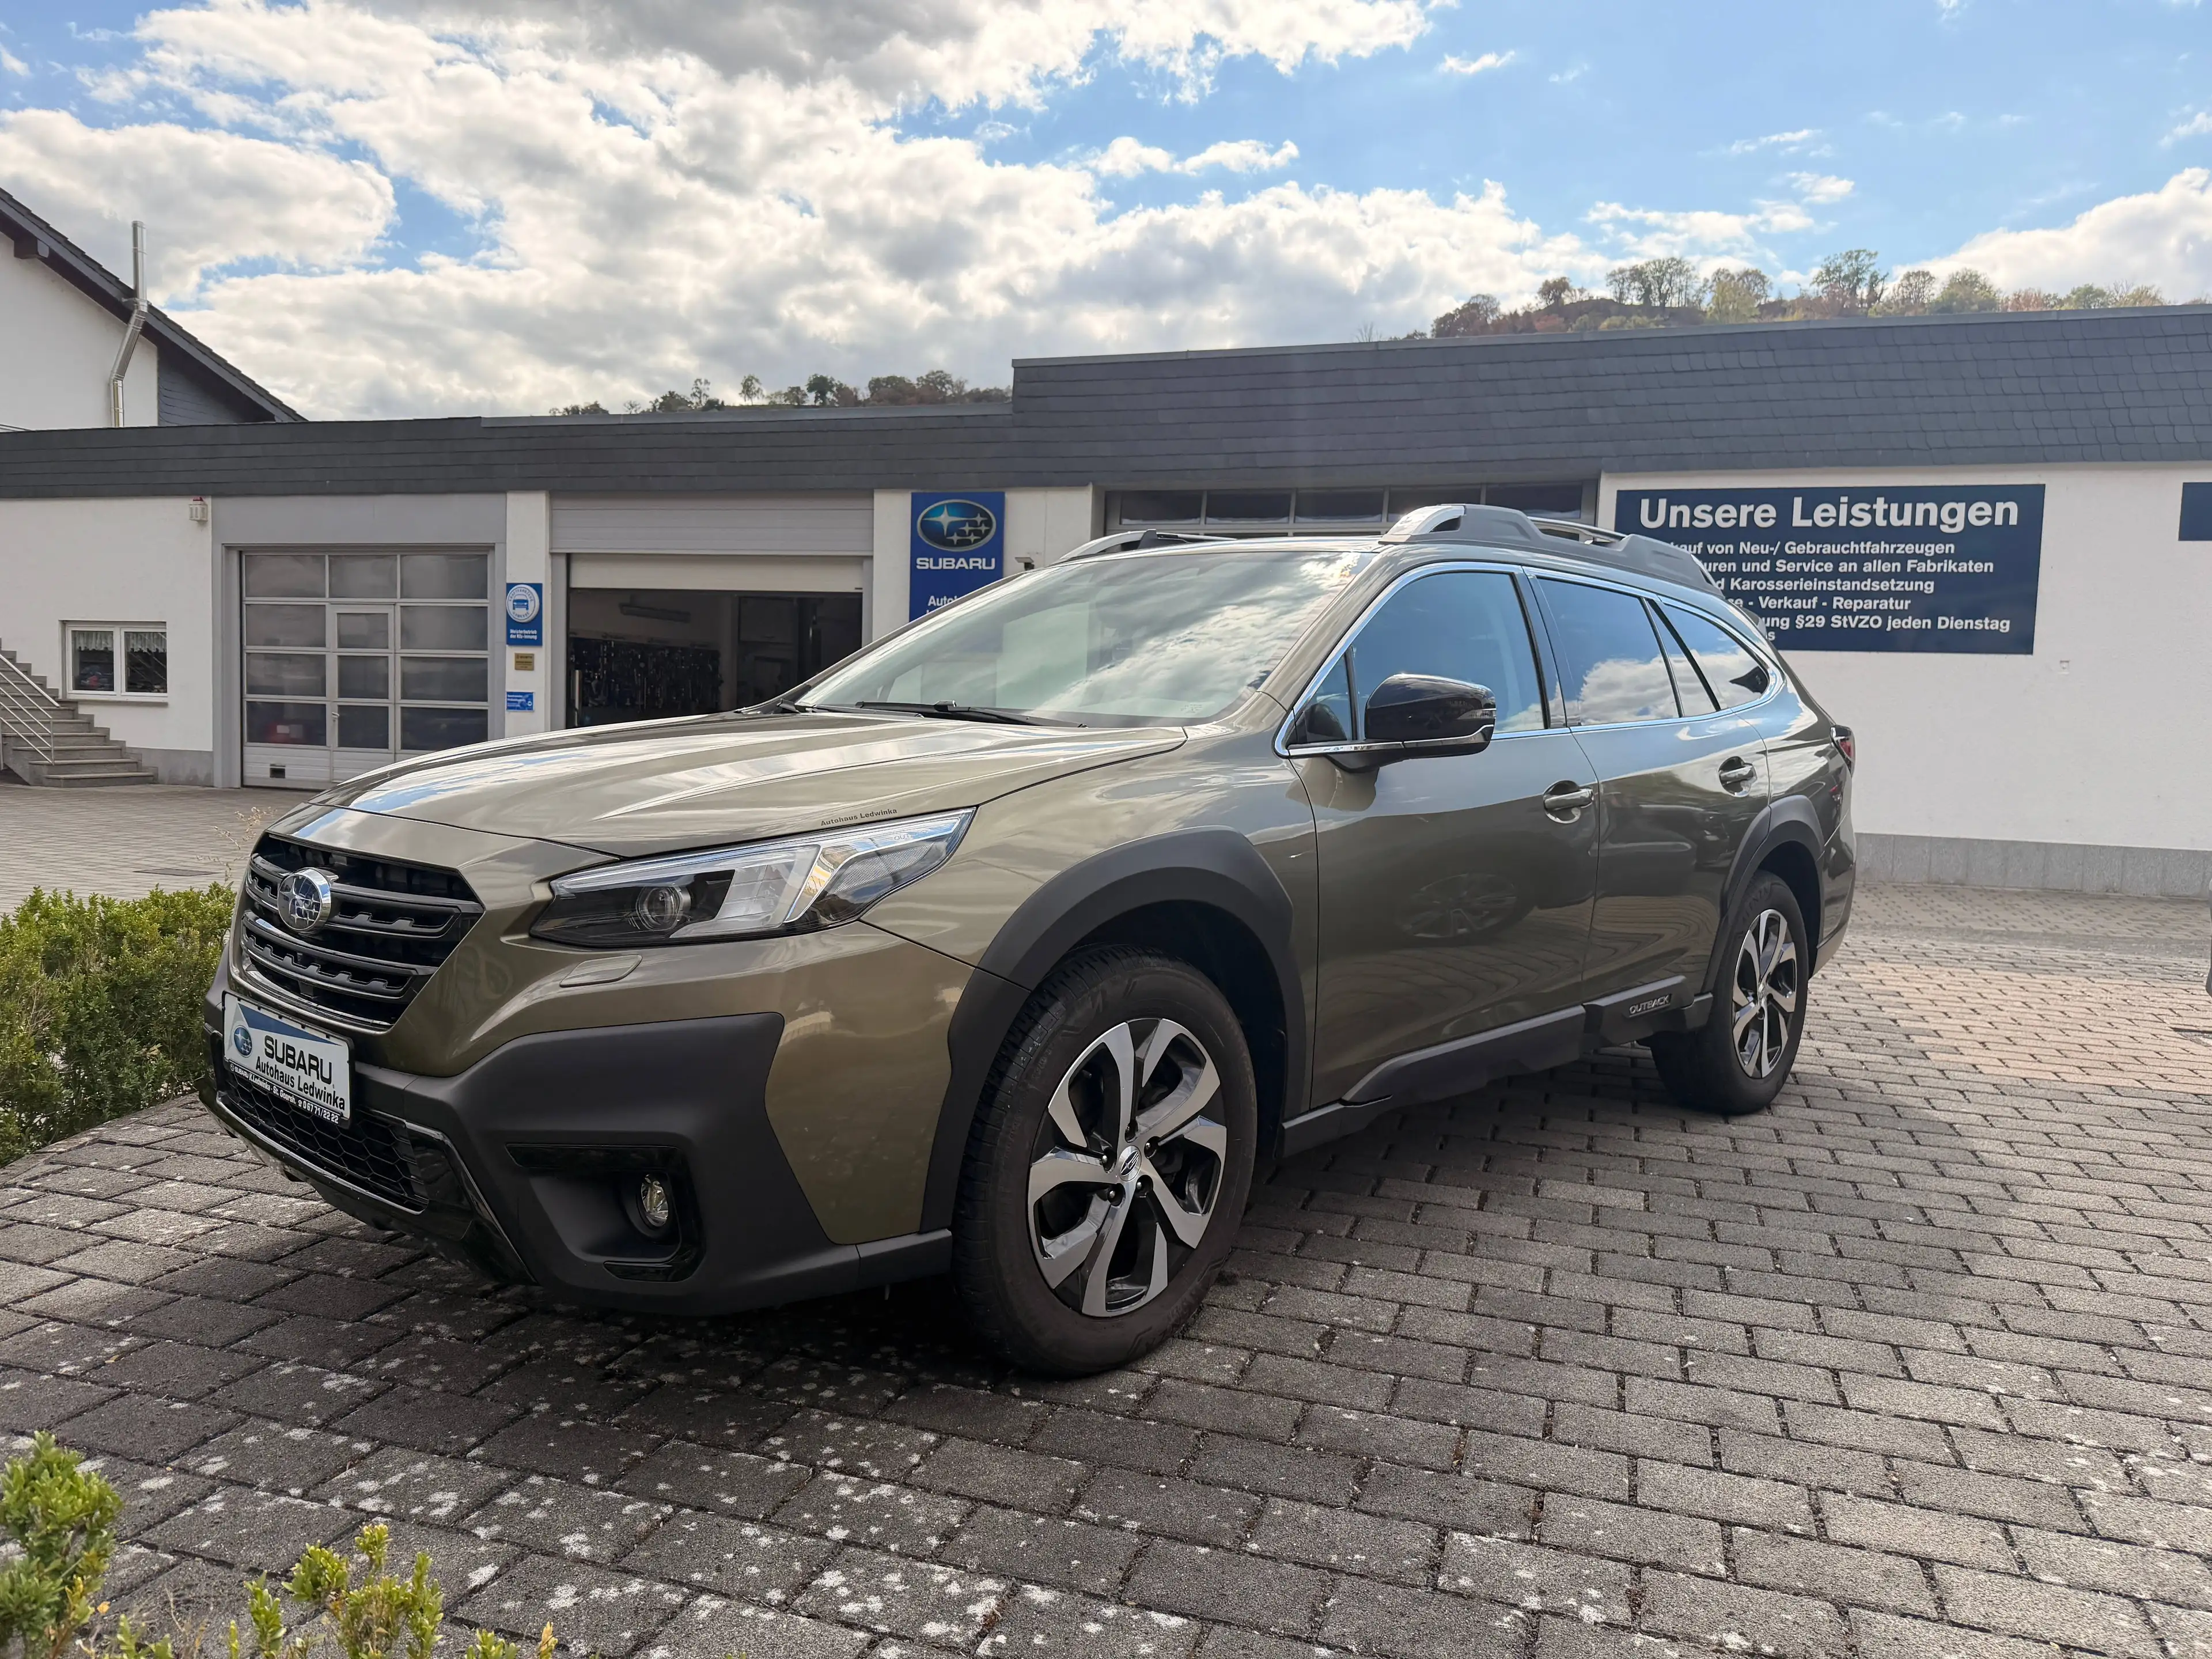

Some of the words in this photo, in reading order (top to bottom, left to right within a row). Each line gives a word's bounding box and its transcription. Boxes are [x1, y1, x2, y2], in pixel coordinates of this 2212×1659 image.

[1641, 498, 1777, 529] Unsere
[1792, 496, 2018, 533] Leistungen
[1707, 544, 1734, 554] von
[1739, 541, 1781, 555] Neu-/
[1785, 541, 1955, 556] Gebrauchtfahrzeugen
[916, 558, 995, 570] SUBARU
[1700, 561, 1736, 572] uren
[1742, 559, 1770, 572] und
[1775, 559, 1833, 572] Service
[1838, 562, 1858, 573] an
[1862, 559, 1901, 573] allen
[1907, 559, 1994, 573] Fabrikaten
[1730, 578, 1934, 594] Karosserieinstandsetzung
[1758, 596, 1818, 609] Verkauf
[1832, 596, 1911, 612] Reparatur
[1795, 615, 1825, 628] §29
[1830, 615, 1882, 628] StVZO
[1887, 616, 1931, 631] jeden
[1937, 616, 2010, 633] Dienstag
[821, 815, 858, 826] Autohaus
[860, 809, 897, 819] Ledwinka
[1630, 995, 1670, 1014] OUTBACK
[264, 1035, 332, 1085] SUBARU
[256, 1056, 294, 1088] Autohaus
[298, 1075, 345, 1111] Ledwinka
